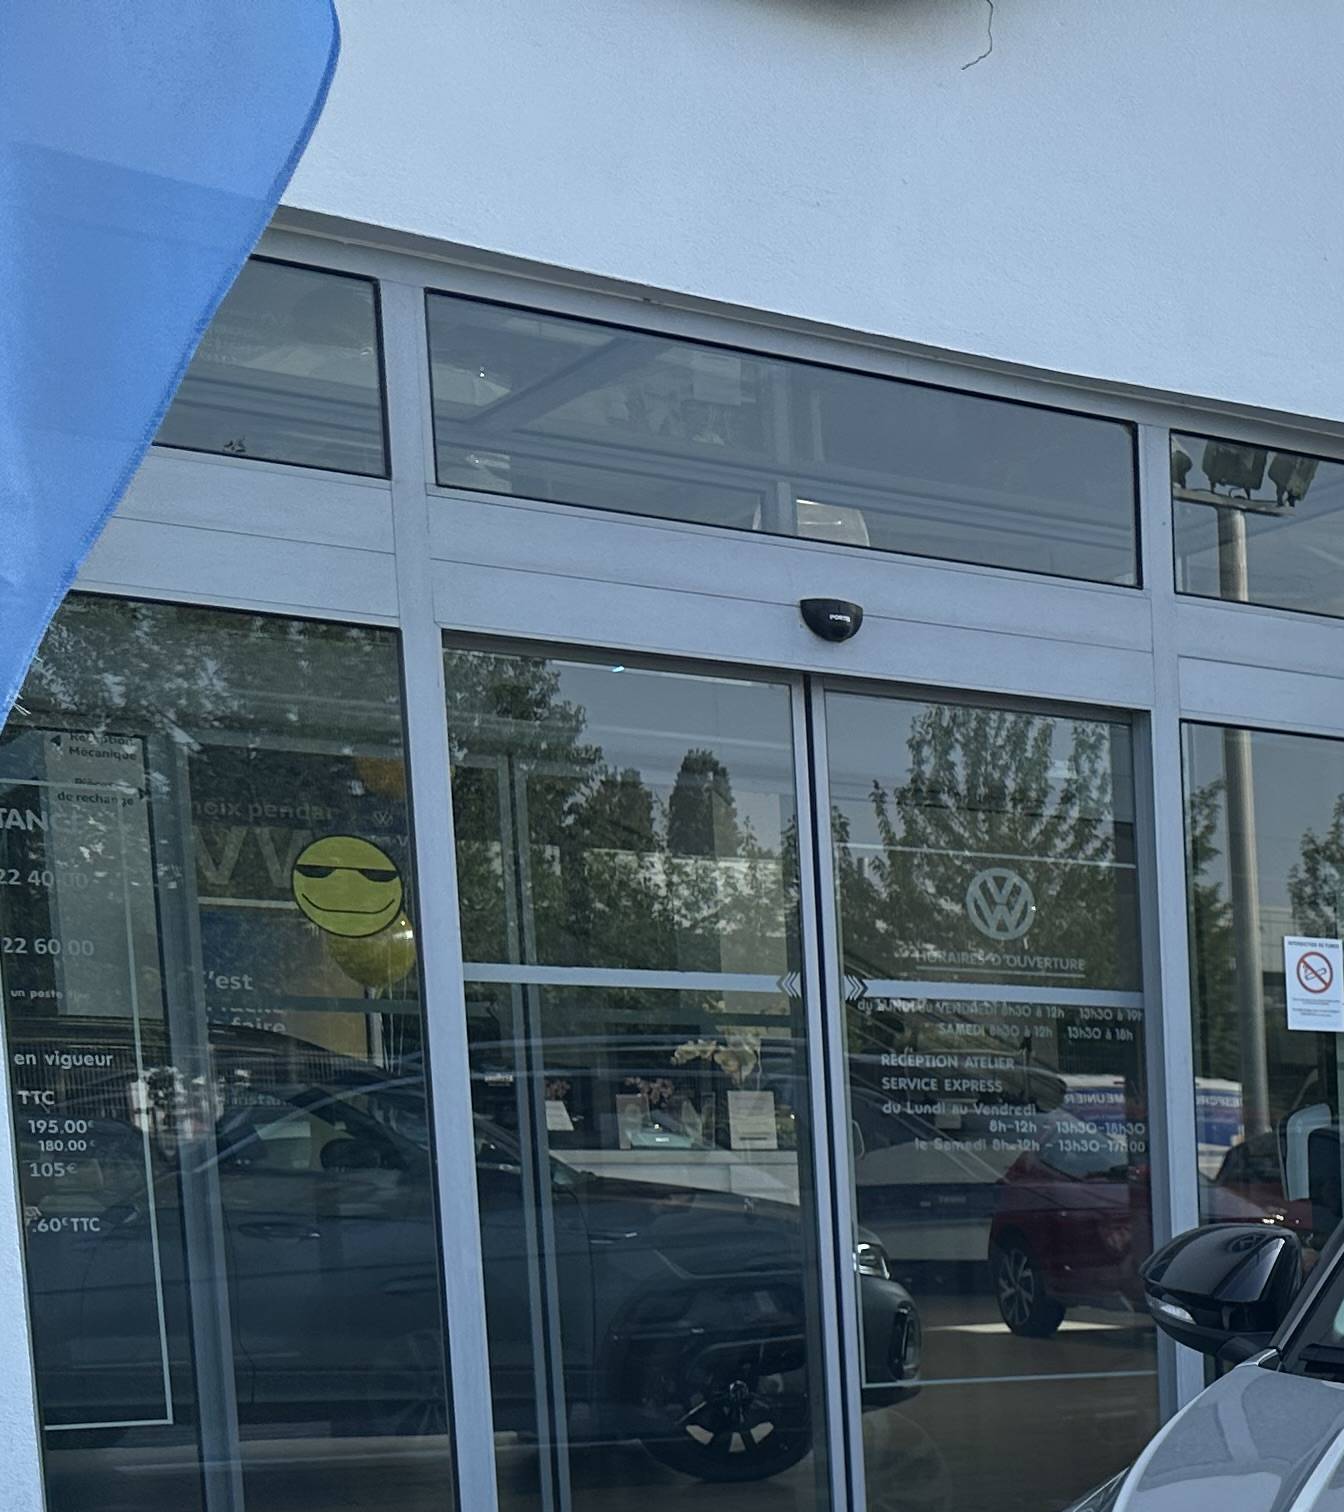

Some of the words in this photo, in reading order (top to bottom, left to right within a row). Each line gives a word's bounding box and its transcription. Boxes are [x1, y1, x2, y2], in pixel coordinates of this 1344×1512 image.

[34, 938, 61, 955] 60
[203, 970, 254, 990] 'est
[14, 1053, 37, 1065] en
[45, 1050, 113, 1070] vigueur
[964, 1055, 1015, 1070] ATELIER
[882, 1076, 938, 1091] SERVICE
[944, 1078, 1003, 1093] EXPRESS
[17, 1090, 55, 1105] TTC
[882, 1100, 902, 1114] du
[906, 1101, 946, 1116] Lundi
[973, 1103, 1037, 1117] Vendredi
